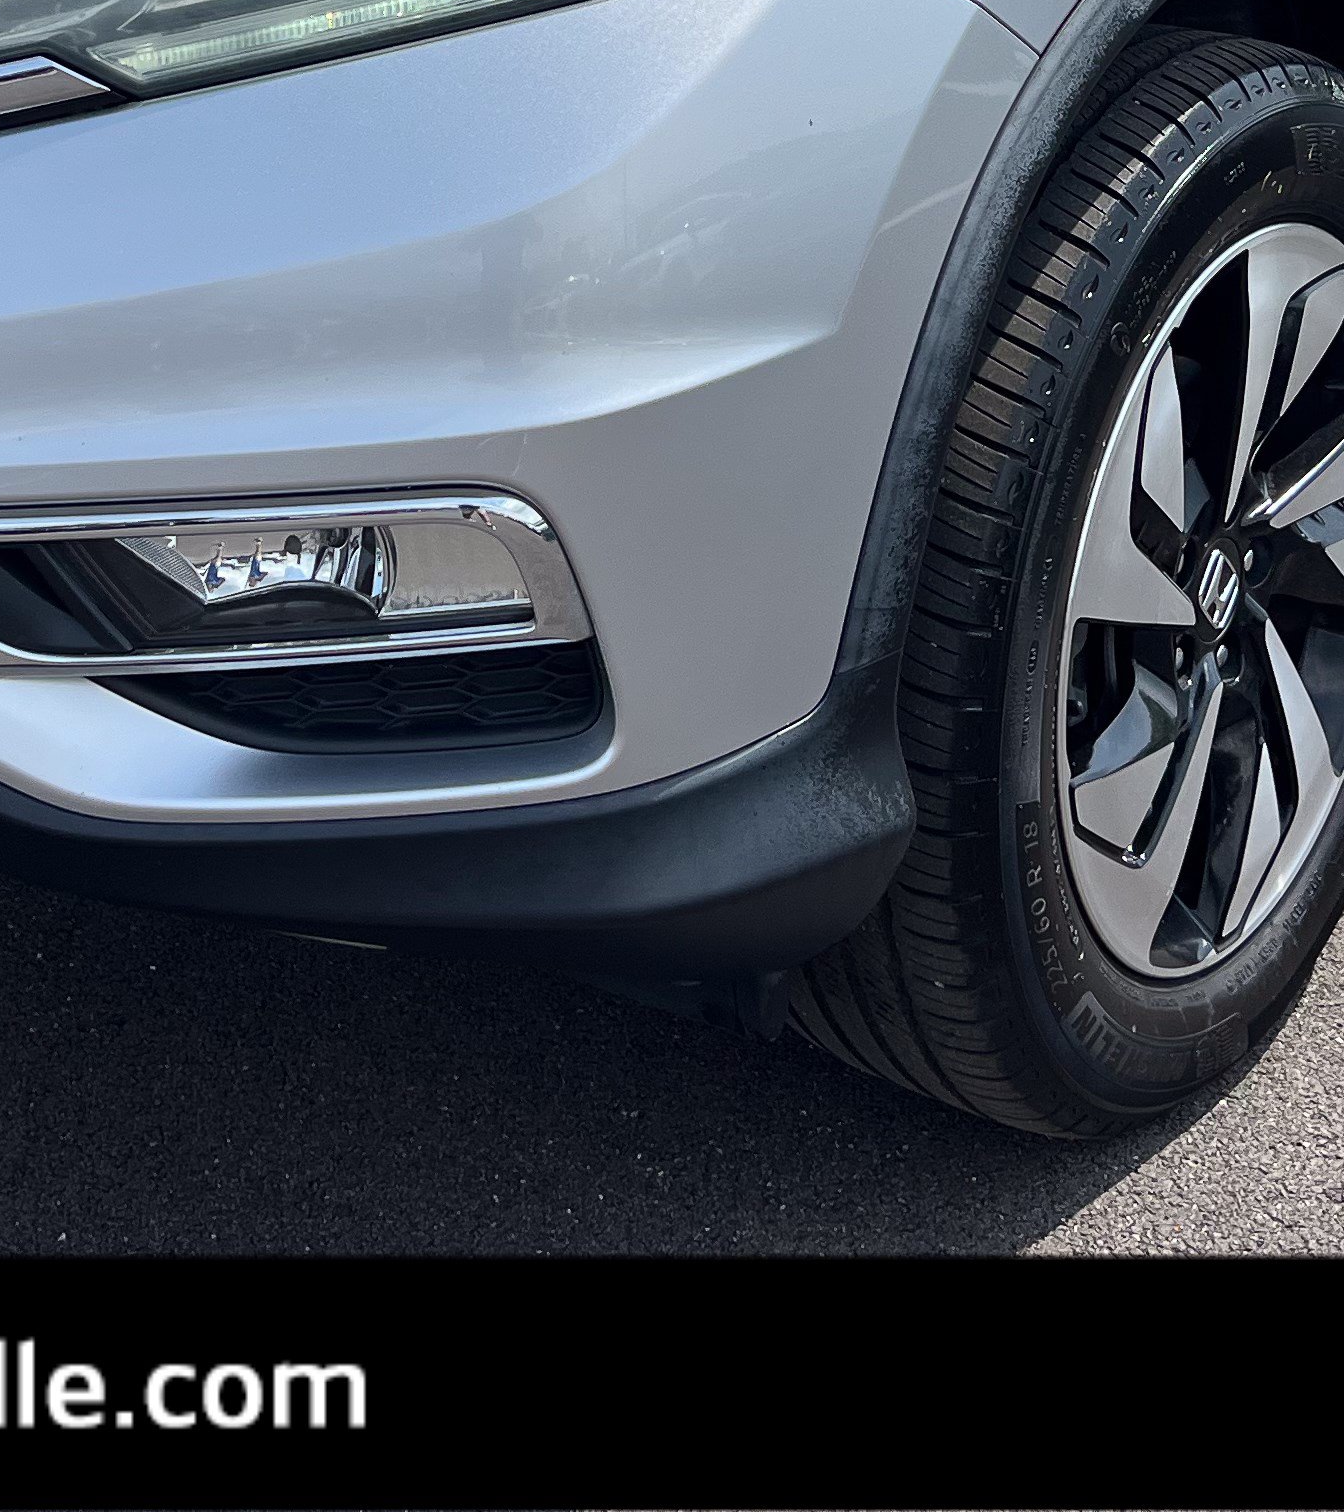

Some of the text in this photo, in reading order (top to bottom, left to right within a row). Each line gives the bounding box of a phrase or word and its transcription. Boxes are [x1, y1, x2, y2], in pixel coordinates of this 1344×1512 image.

[1022, 820, 1068, 993] 225/60 R 18
